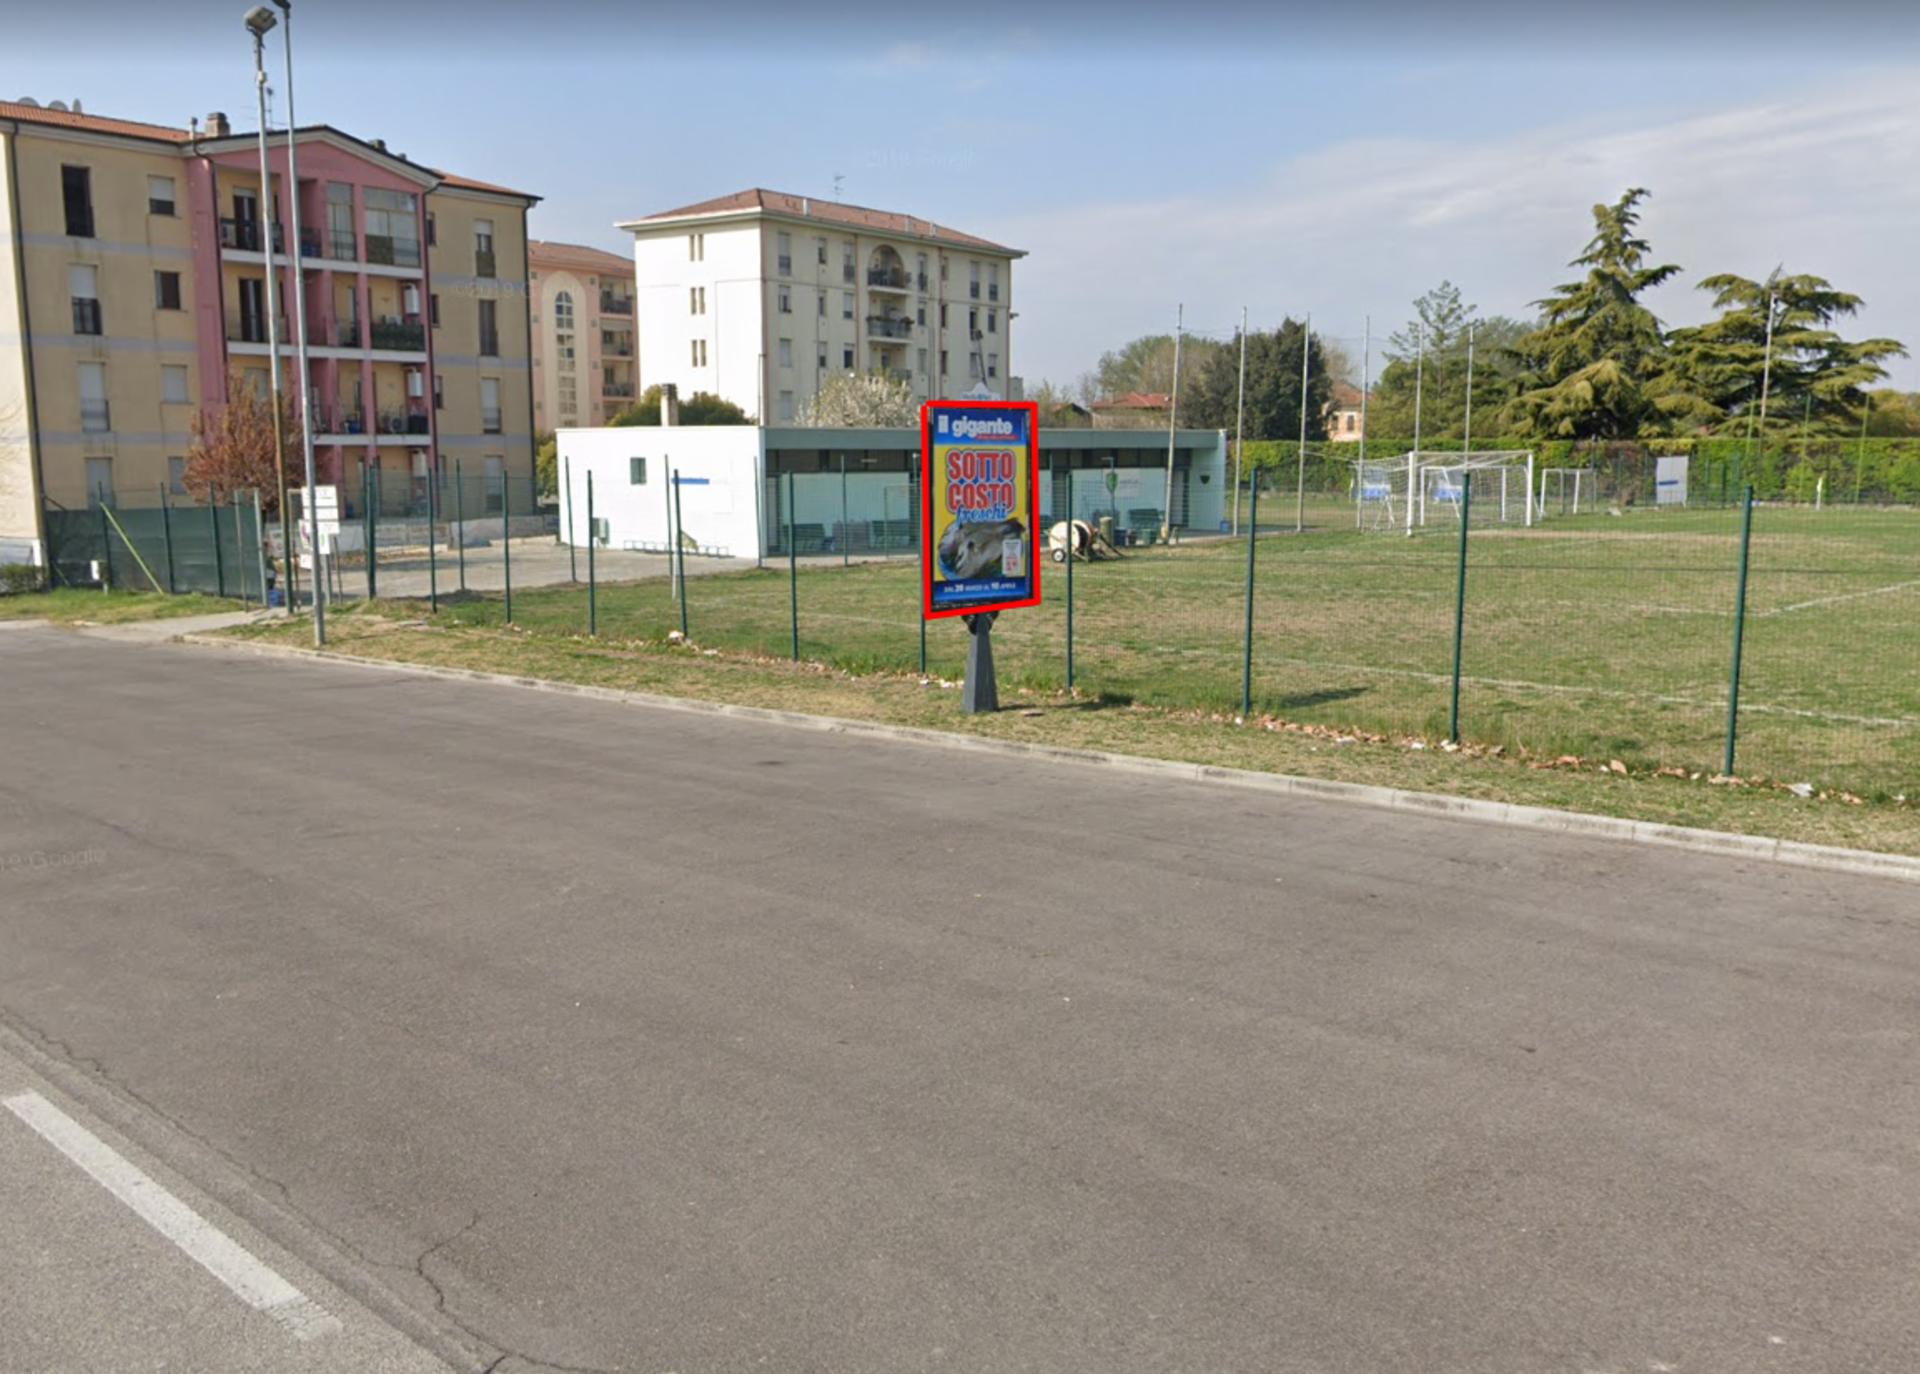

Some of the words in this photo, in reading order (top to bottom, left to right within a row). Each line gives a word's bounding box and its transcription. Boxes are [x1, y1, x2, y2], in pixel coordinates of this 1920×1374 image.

[952, 415, 1013, 437] gigante
[947, 450, 1014, 481] SOTTO
[947, 482, 1014, 512] COSTO
[956, 502, 1008, 523] freschi
